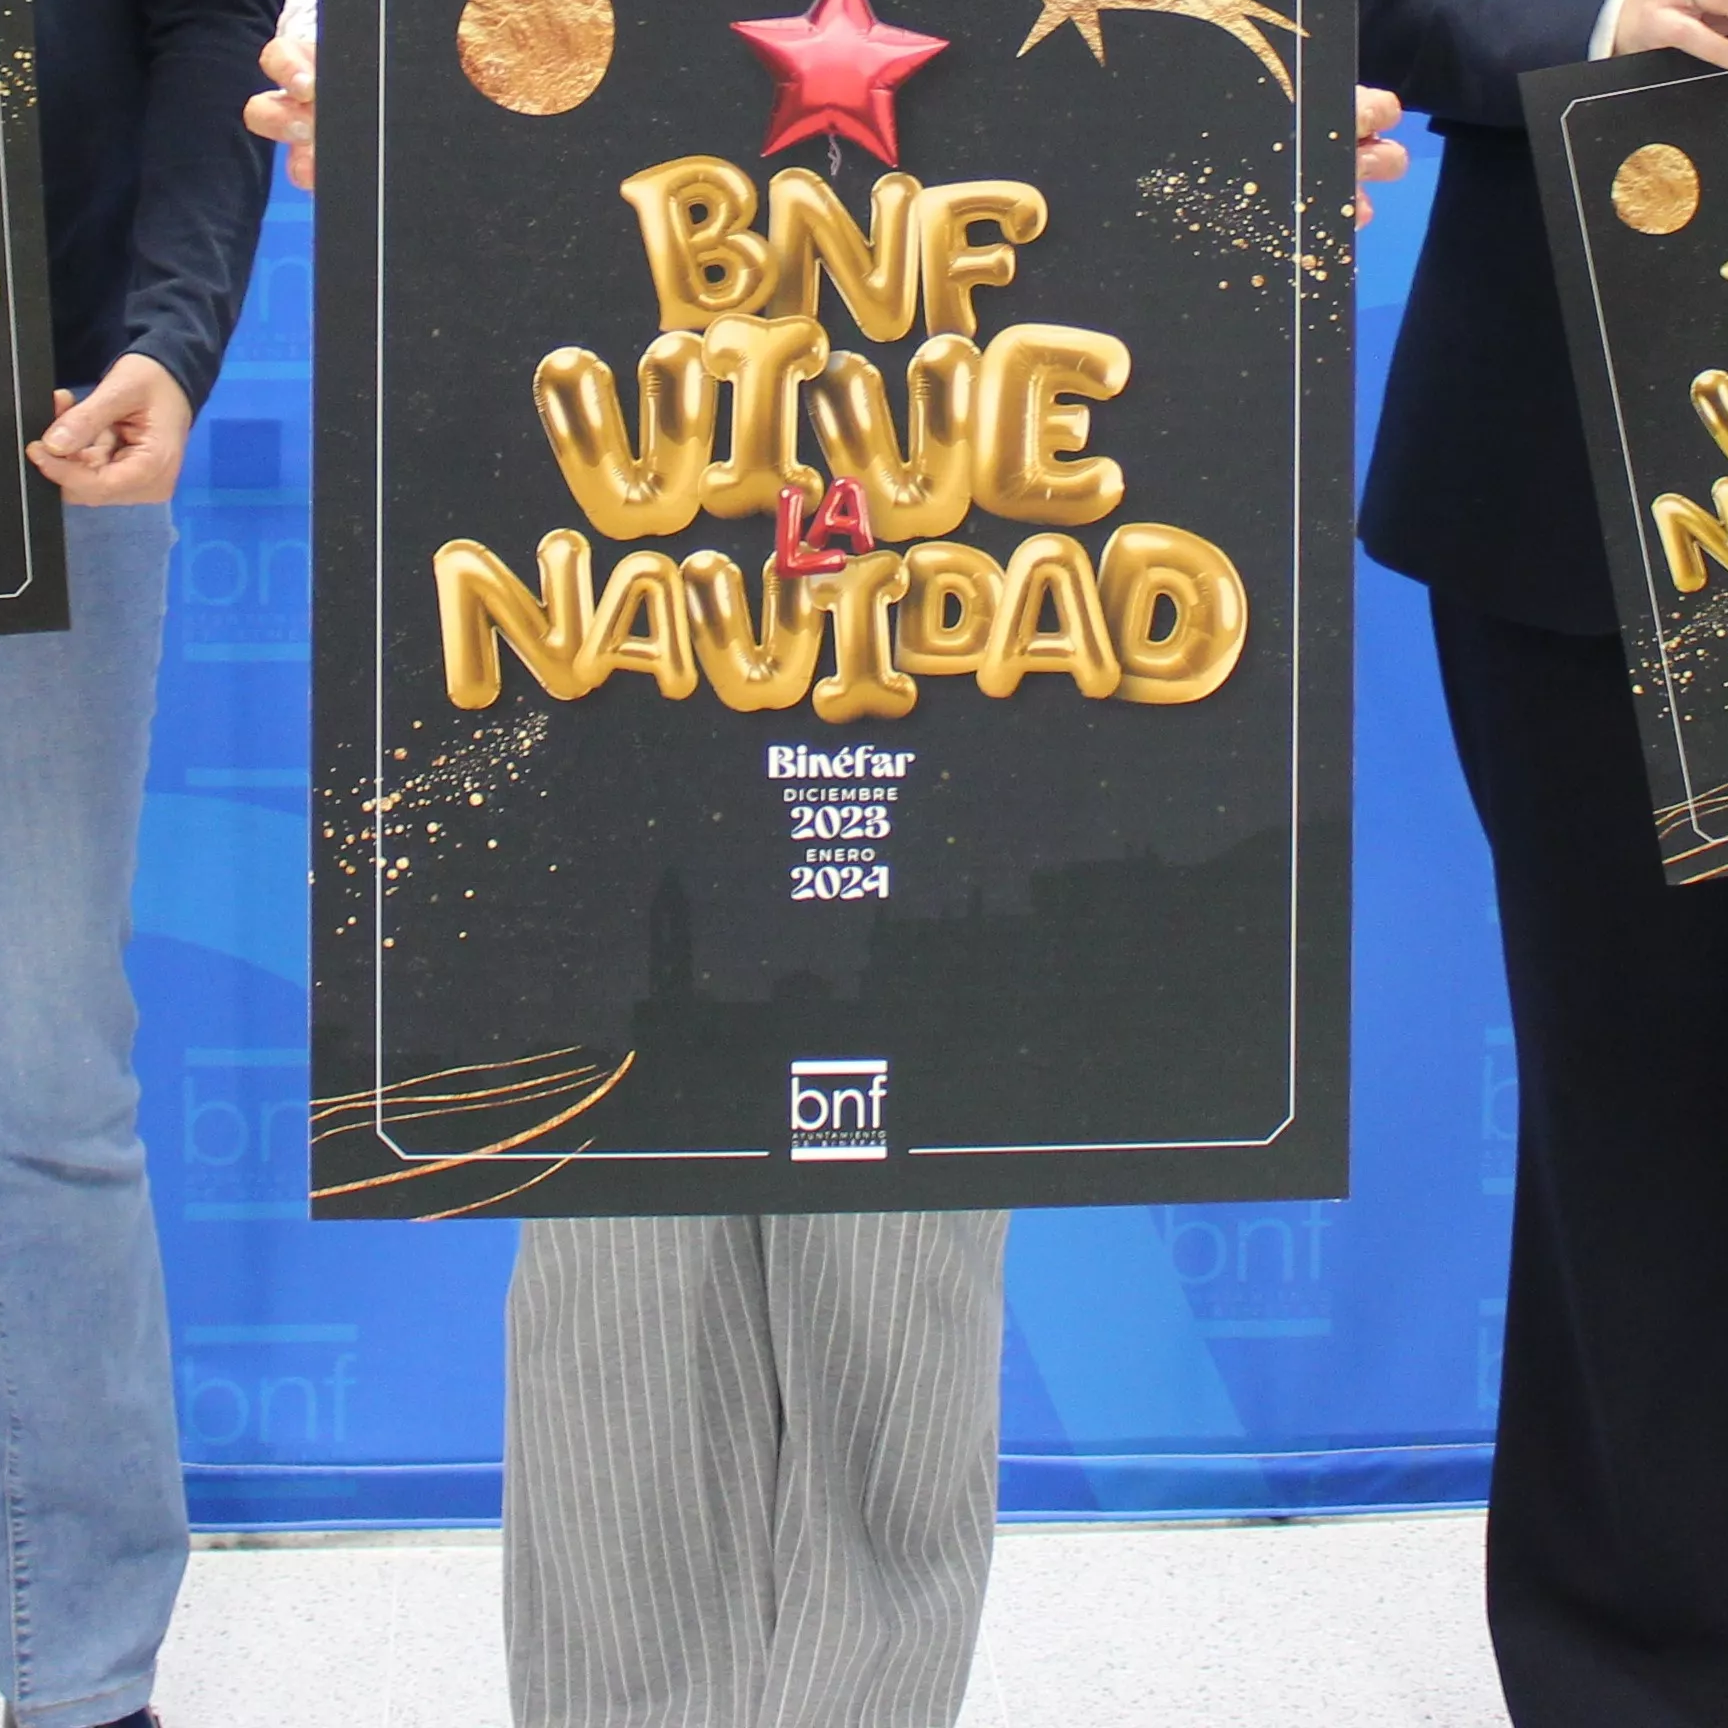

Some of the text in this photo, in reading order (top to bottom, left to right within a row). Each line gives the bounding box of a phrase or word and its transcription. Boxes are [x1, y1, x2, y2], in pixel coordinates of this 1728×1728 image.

[620, 155, 1047, 340] BNF
[532, 314, 1130, 540] VIVE
[774, 477, 873, 575] LA
[433, 523, 1248, 722] NAVIDAD
[767, 744, 916, 779] Binéfar
[783, 787, 899, 802] DICIEMBRE
[790, 805, 891, 840] 2023
[806, 848, 875, 862] ENERO
[790, 866, 889, 900] 2024
[791, 1075, 888, 1131] bnf
